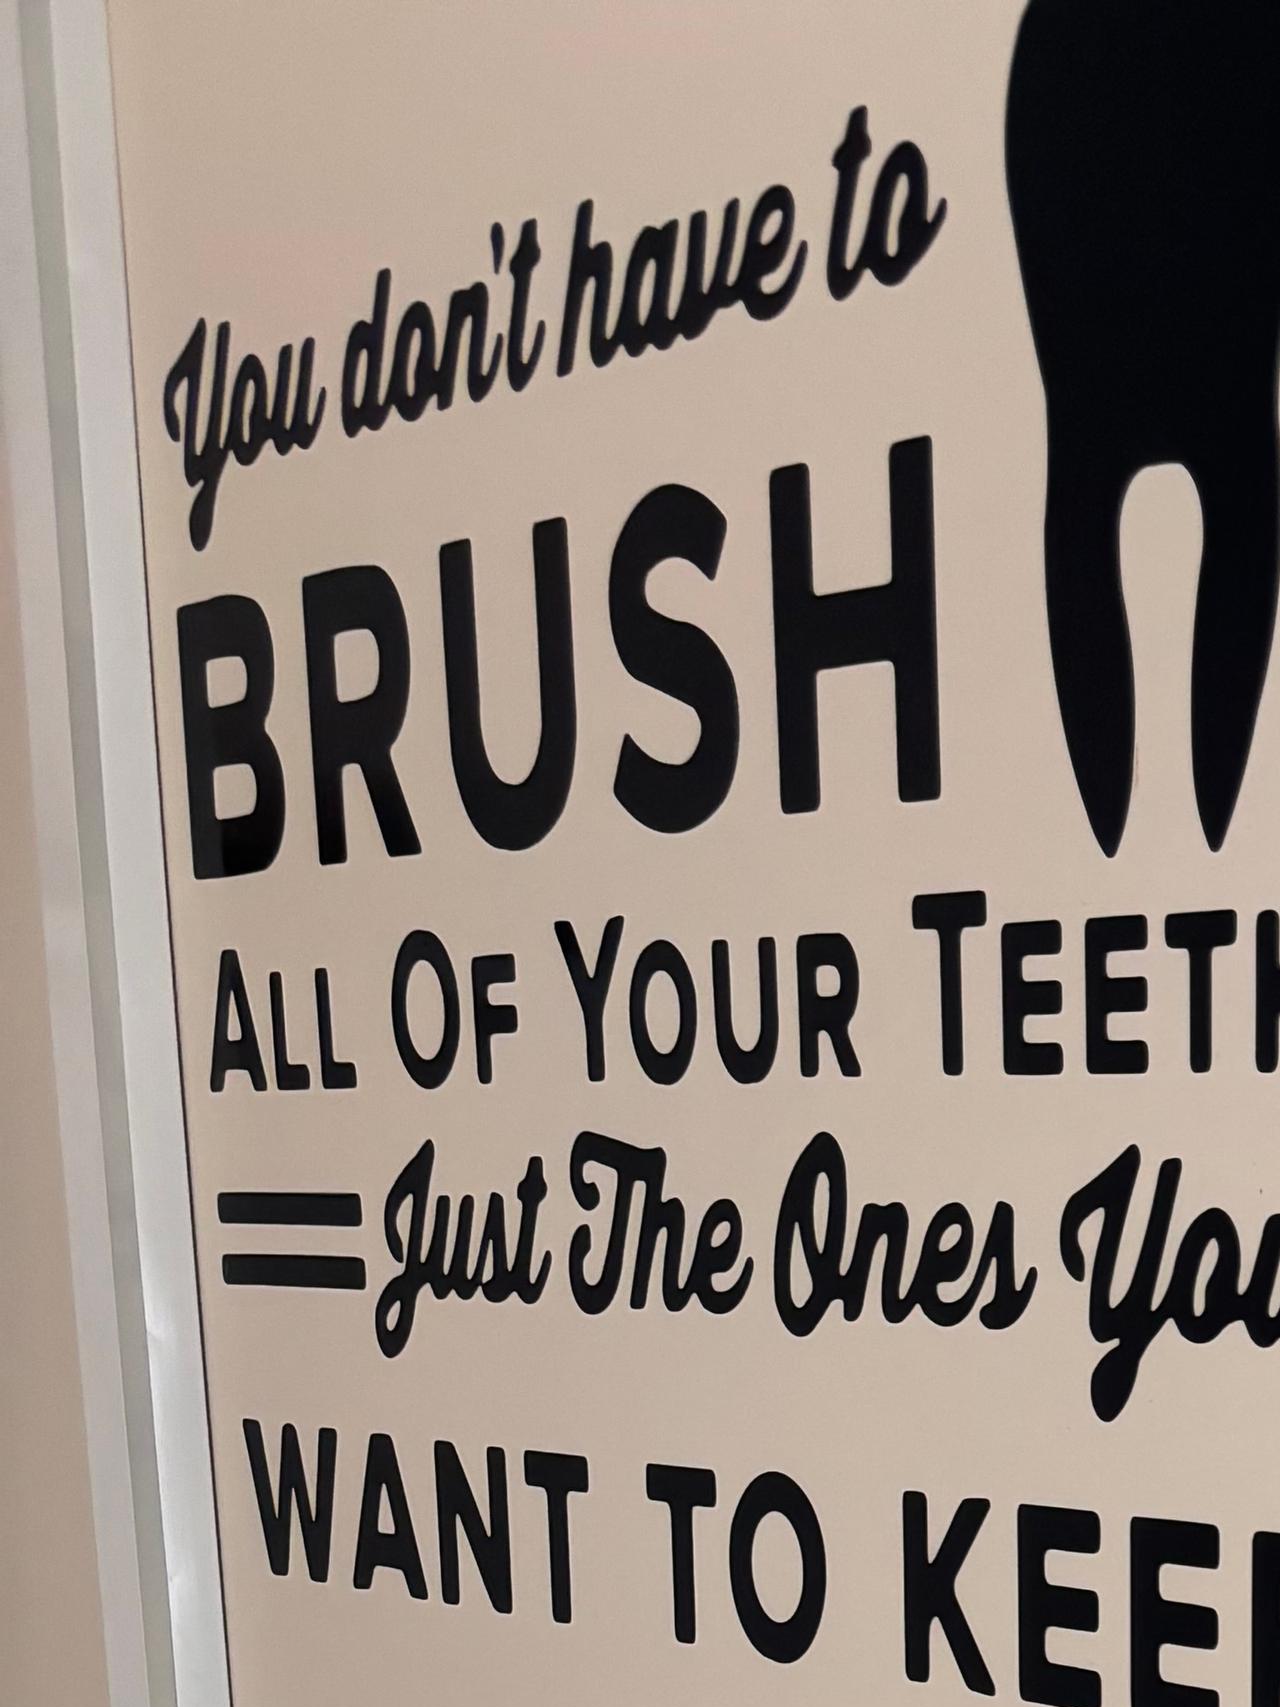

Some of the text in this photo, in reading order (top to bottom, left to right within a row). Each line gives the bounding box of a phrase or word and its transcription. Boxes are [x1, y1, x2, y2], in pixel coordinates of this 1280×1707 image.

[161, 103, 949, 553] You don't have to
[175, 434, 943, 881] BRUSH
[208, 948, 359, 1094] ALL
[389, 928, 520, 1091] OF
[552, 914, 863, 1087] YOUR
[373, 1137, 553, 1360] Just
[567, 1129, 755, 1316] The
[772, 1130, 1039, 1339] Ones
[241, 1417, 591, 1625] WANT
[644, 1462, 829, 1665] TO
